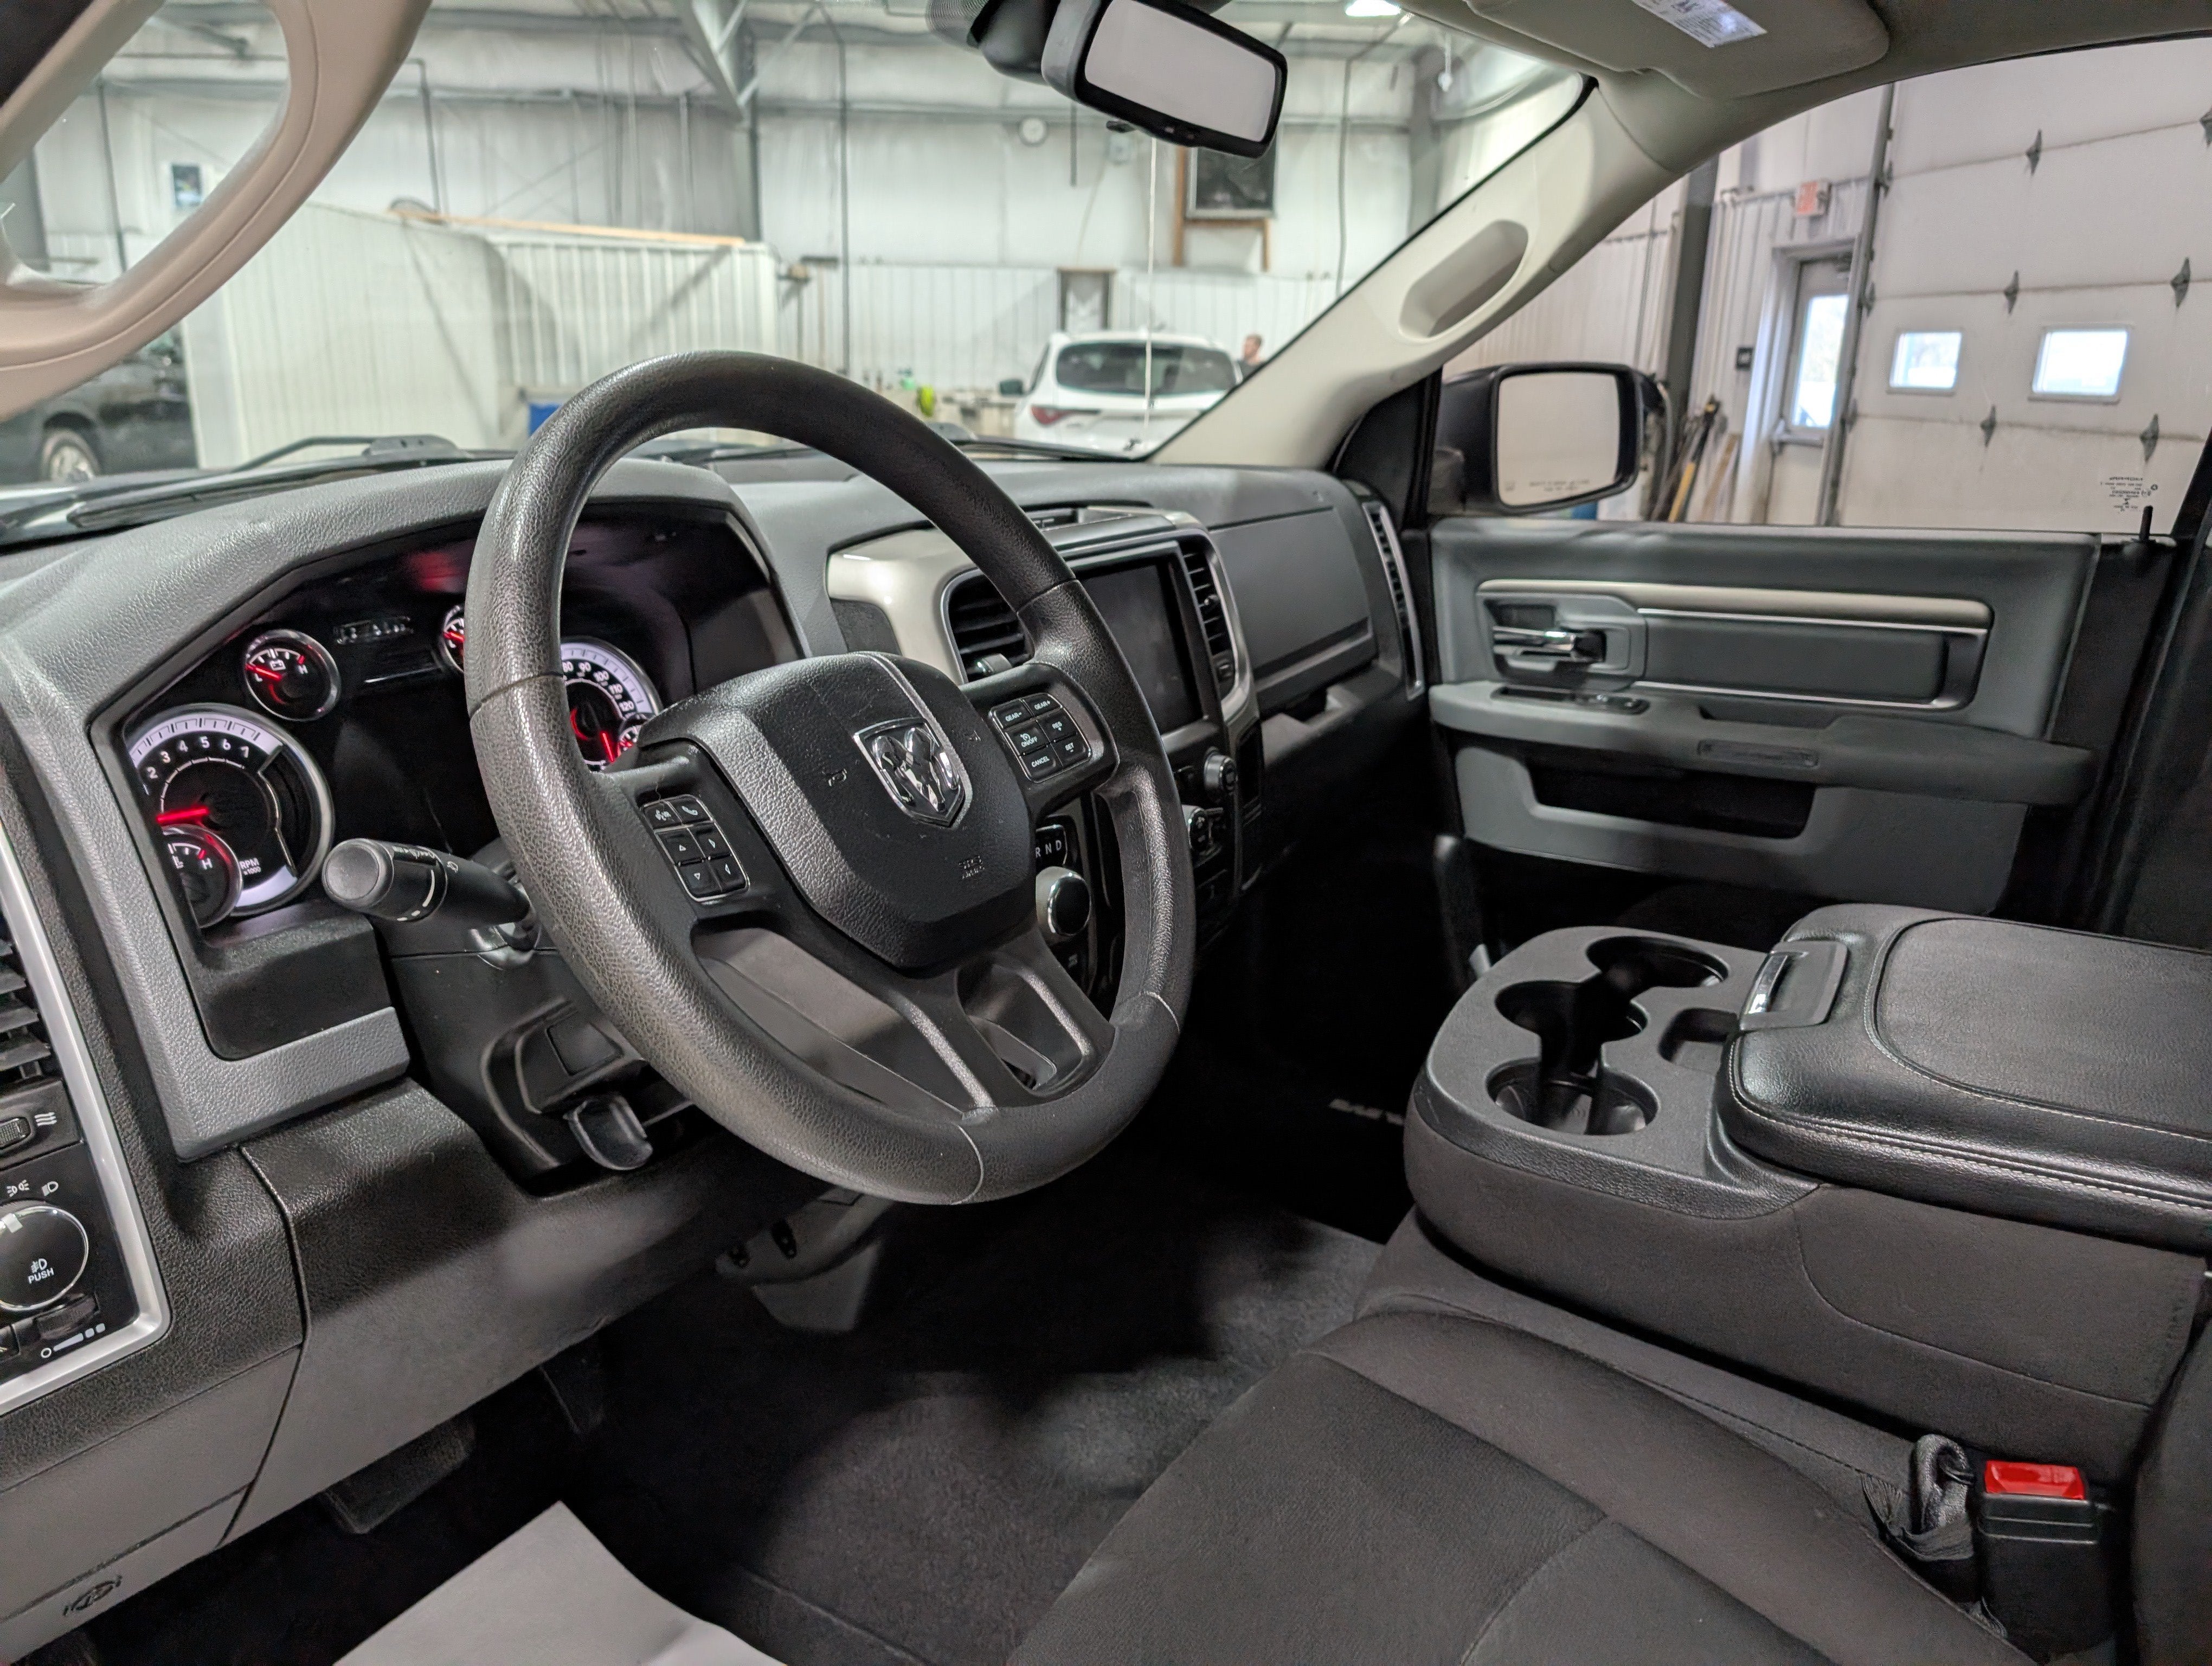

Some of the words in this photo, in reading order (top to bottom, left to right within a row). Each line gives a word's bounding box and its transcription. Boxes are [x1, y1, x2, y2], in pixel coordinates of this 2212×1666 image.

[578, 662, 591, 672] 90
[593, 670, 610, 682] 100
[608, 683, 623, 695] 110
[619, 701, 635, 712] 120
[1064, 742, 1074, 751] SET
[146, 766, 158, 779] 2
[160, 751, 171, 764] 3
[178, 739, 189, 753] 4
[199, 735, 210, 748] 5
[222, 738, 232, 751] 6
[240, 745, 249, 758] 7
[1031, 755, 1050, 767] CANCEL
[1035, 847, 1041, 858] R
[1045, 842, 1052, 855] N
[1055, 840, 1062, 851] D
[201, 857, 213, 870] H
[239, 857, 260, 869] RPM
[27, 1267, 55, 1284] PUSH
